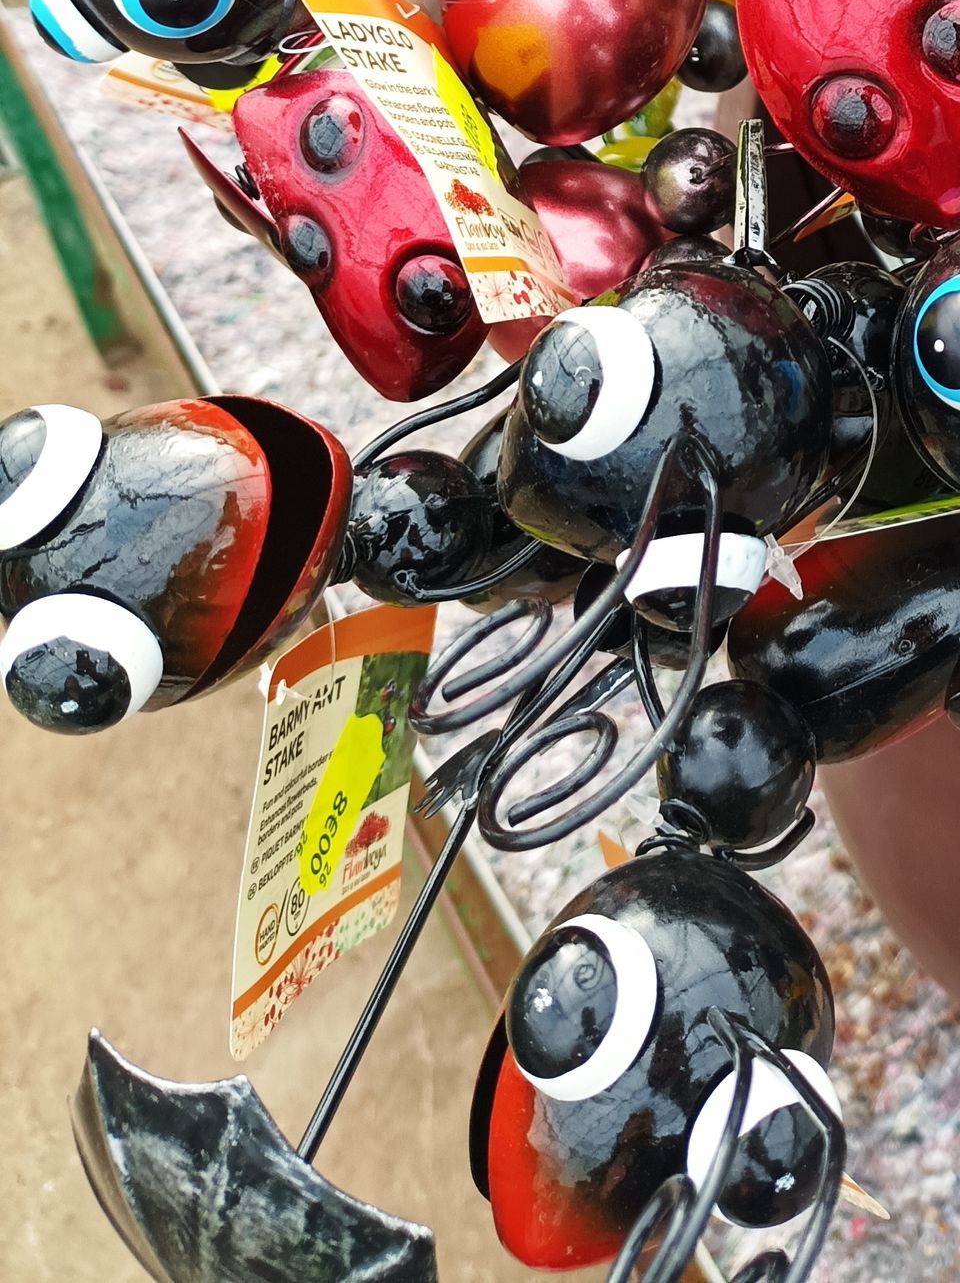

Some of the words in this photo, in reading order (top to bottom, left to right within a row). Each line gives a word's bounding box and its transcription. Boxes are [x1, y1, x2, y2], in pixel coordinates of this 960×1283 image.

[322, 20, 414, 50] LADYGLO
[340, 47, 407, 73] STAKE
[388, 84, 397, 92] in
[396, 84, 412, 94] the
[412, 84, 432, 96] dark
[420, 117, 436, 127] and
[436, 119, 456, 130] pots
[268, 694, 311, 751] BARMY
[264, 730, 304, 786] STAKE
[262, 799, 274, 813] Fun
[274, 786, 285, 804] and
[308, 754, 328, 774] border
[258, 820, 281, 846] borders
[280, 808, 292, 826] and
[291, 800, 304, 818] pots
[260, 802, 286, 832] Enhances
[261, 835, 284, 865] PIQUET
[290, 888, 306, 916] 80
[260, 920, 276, 941] HAND
